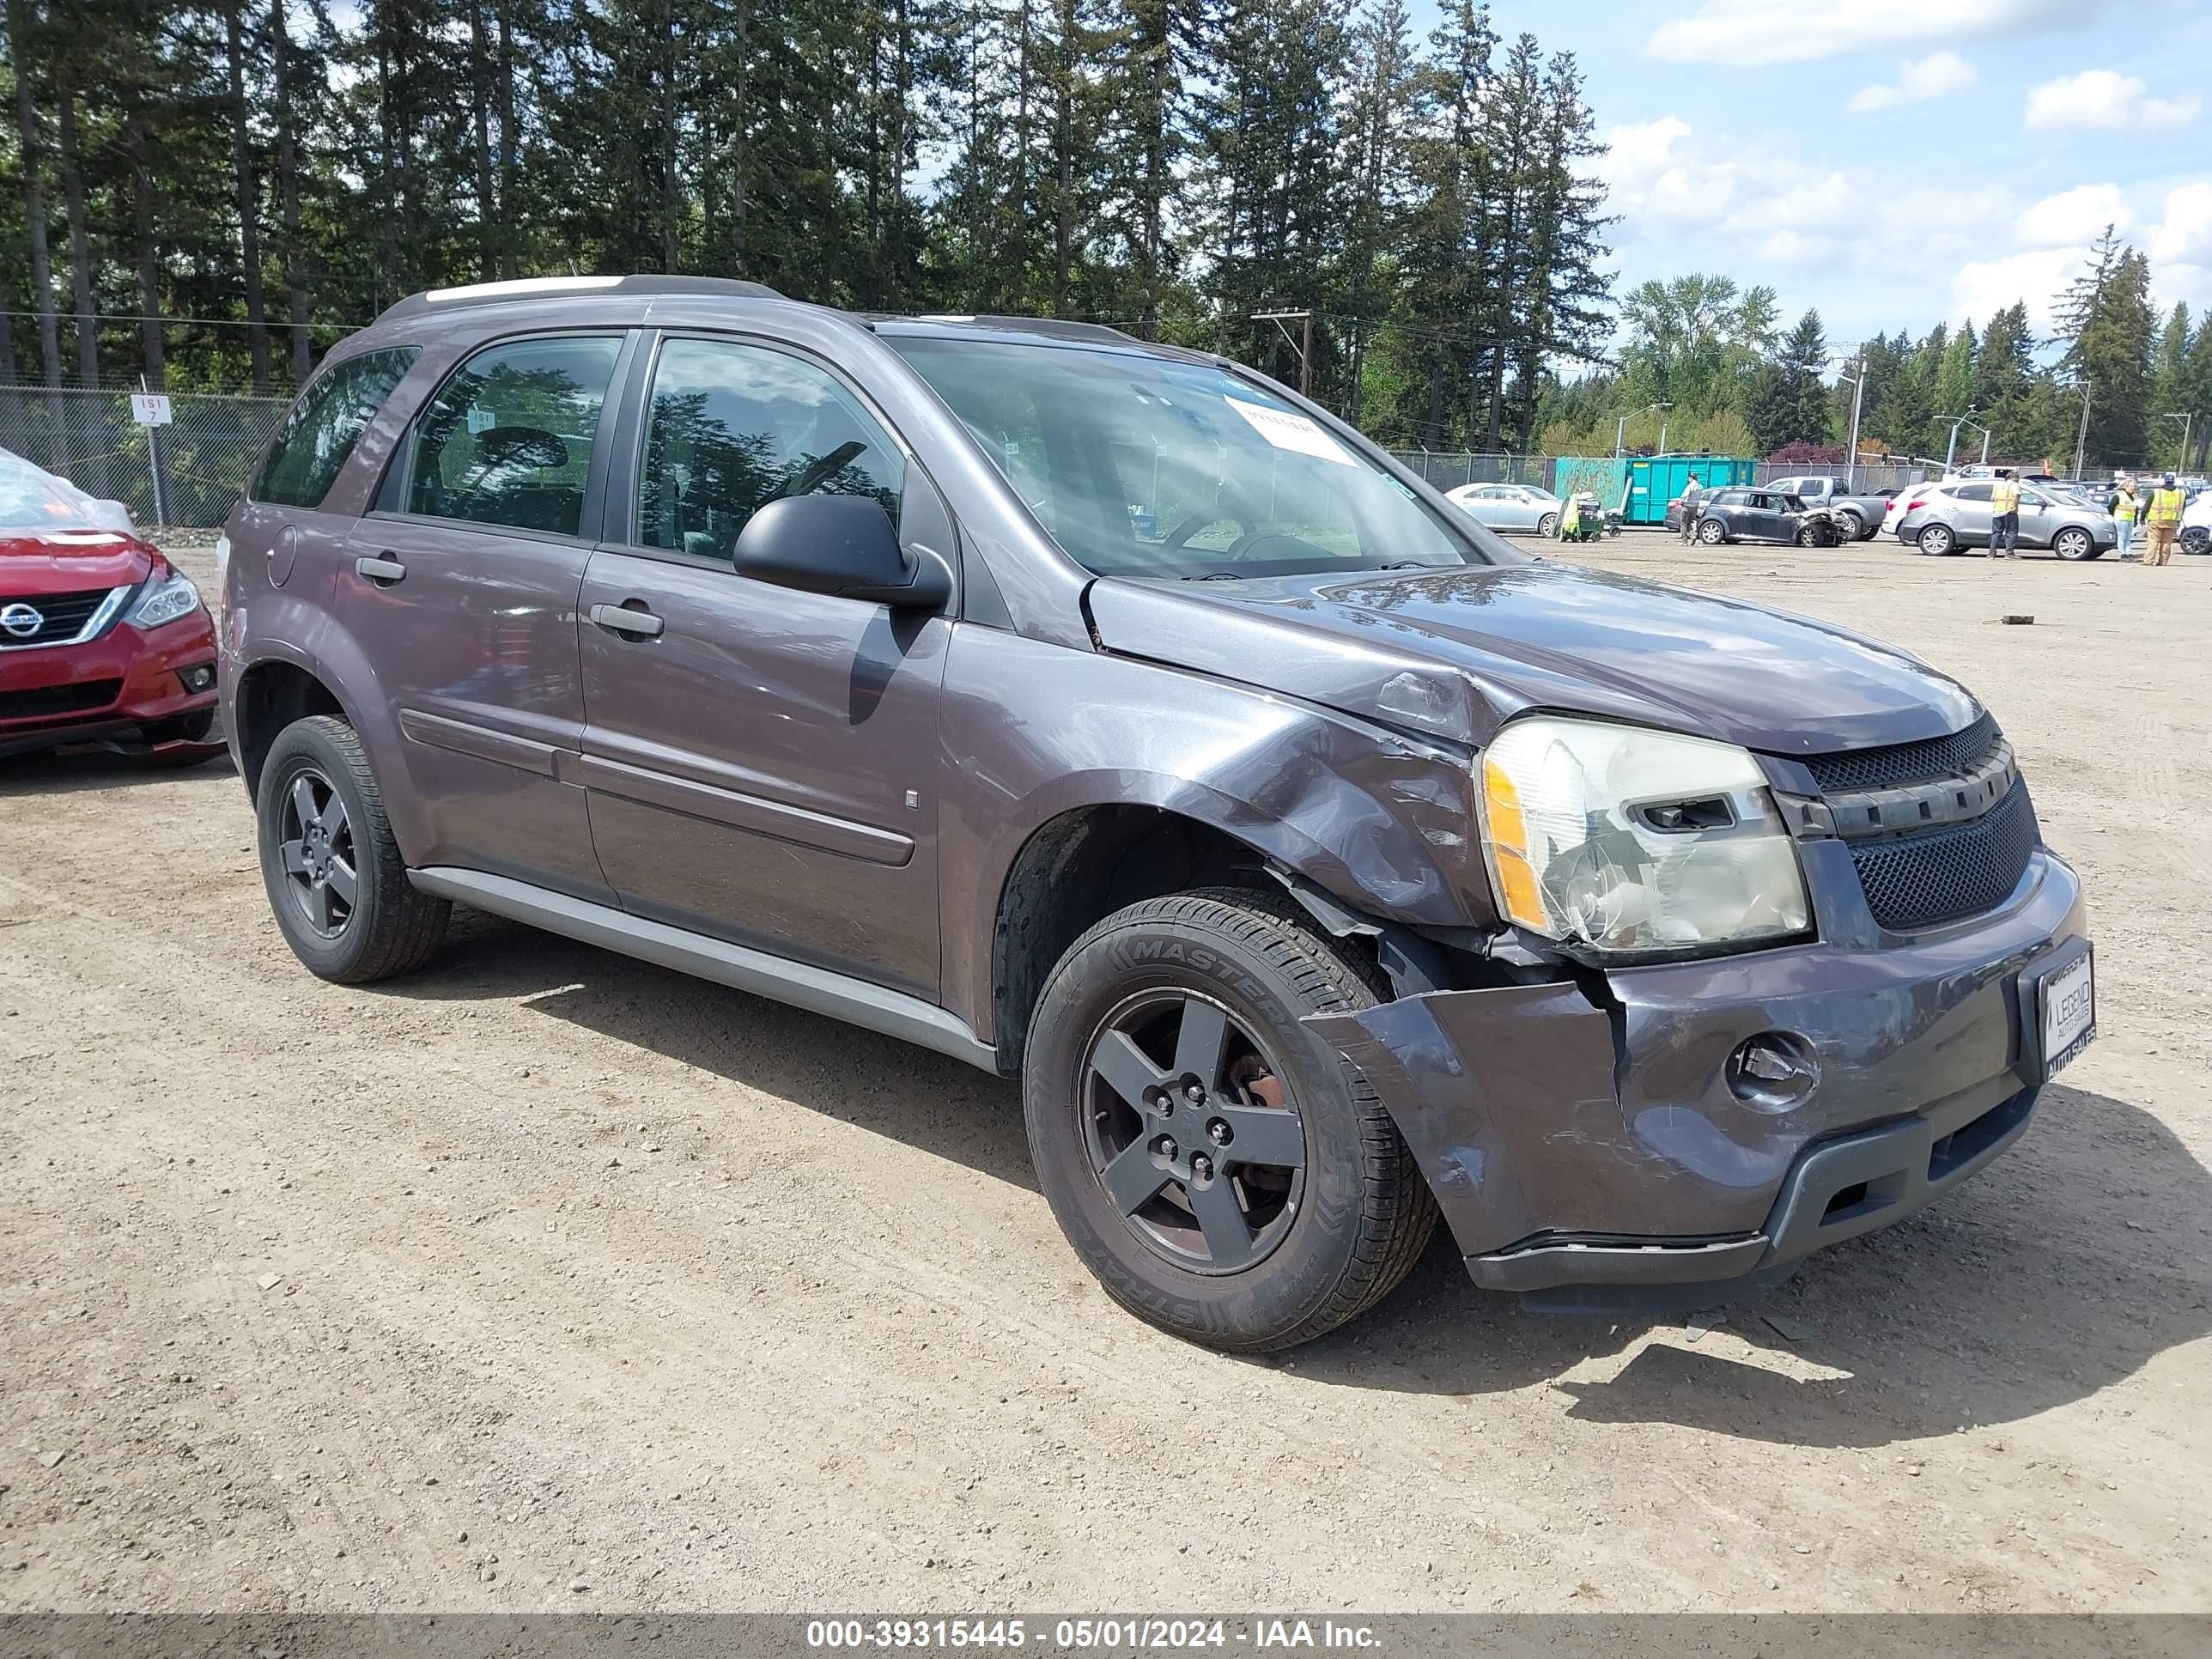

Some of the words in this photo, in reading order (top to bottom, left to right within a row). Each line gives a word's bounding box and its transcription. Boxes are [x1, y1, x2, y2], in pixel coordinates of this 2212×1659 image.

[150, 411, 156, 421] 7
[2056, 980, 2089, 1025] LEGEND
[2048, 1048, 2071, 1081] AUTO
[2072, 1026, 2096, 1061] SALES
